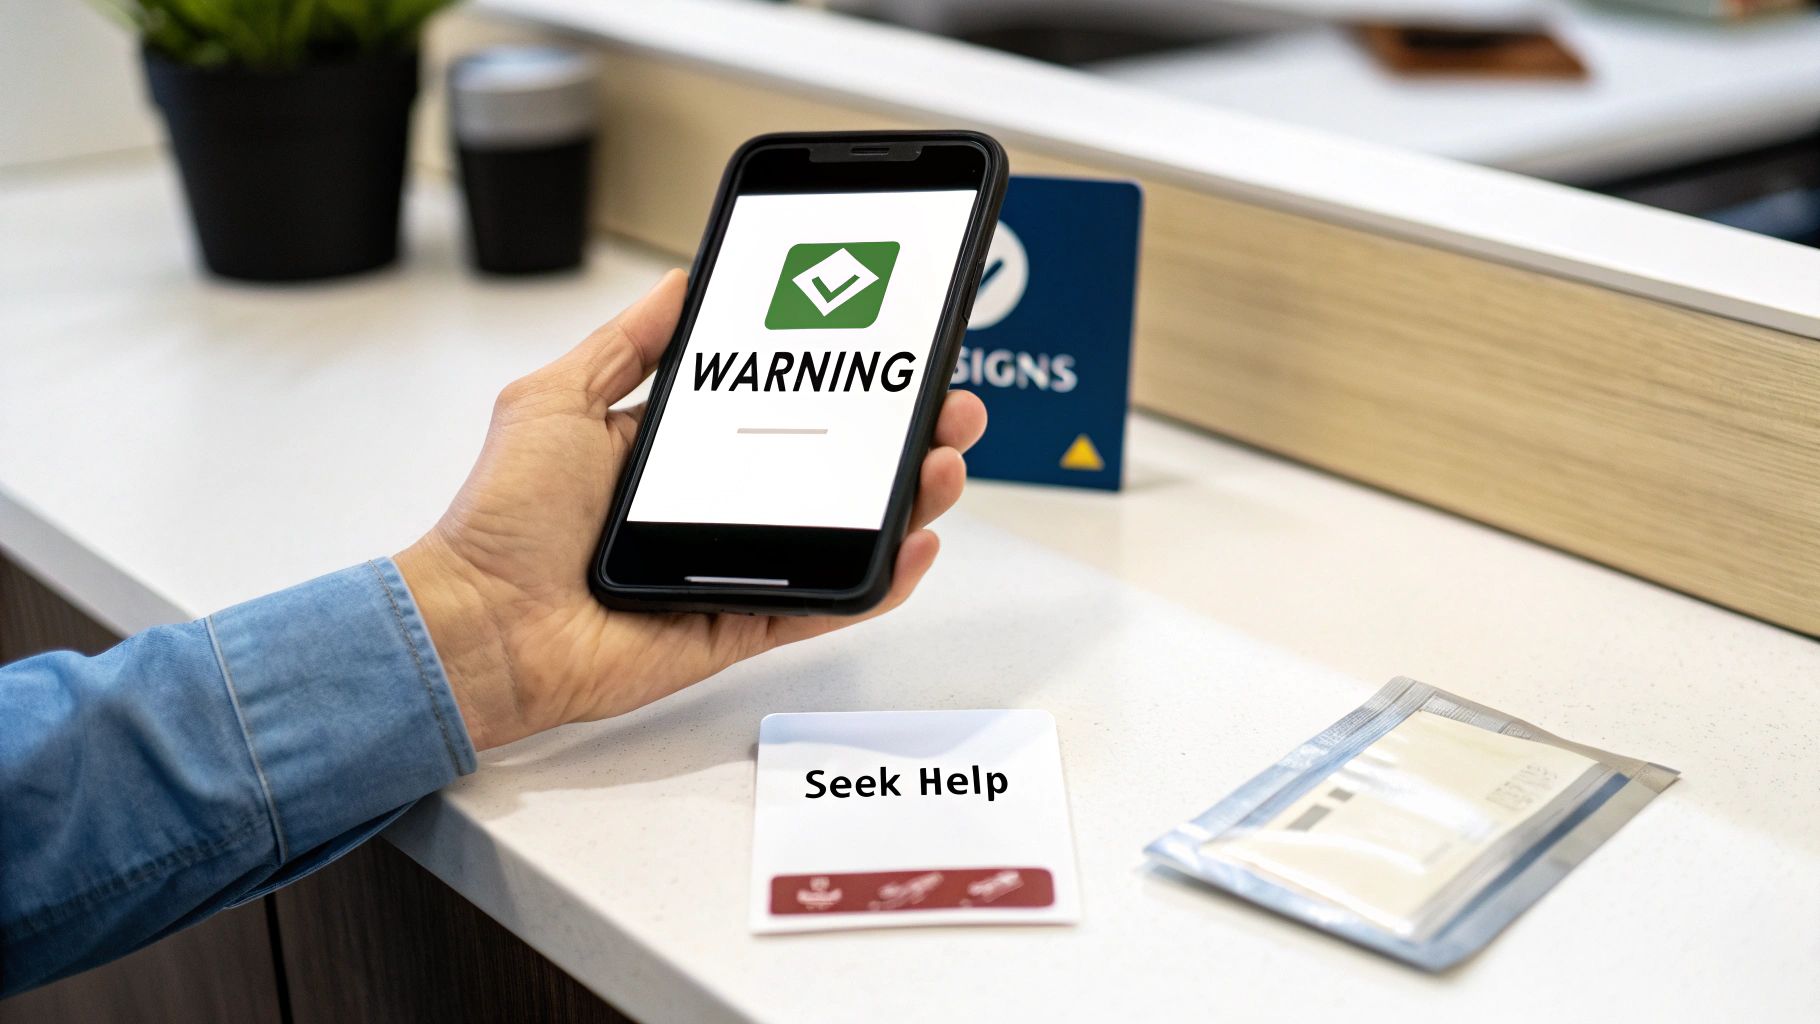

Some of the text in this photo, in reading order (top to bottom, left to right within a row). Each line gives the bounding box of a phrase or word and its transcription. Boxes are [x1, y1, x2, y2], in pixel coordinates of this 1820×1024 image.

[694, 351, 917, 393] WARNING
[805, 765, 1009, 802] Seek Help
